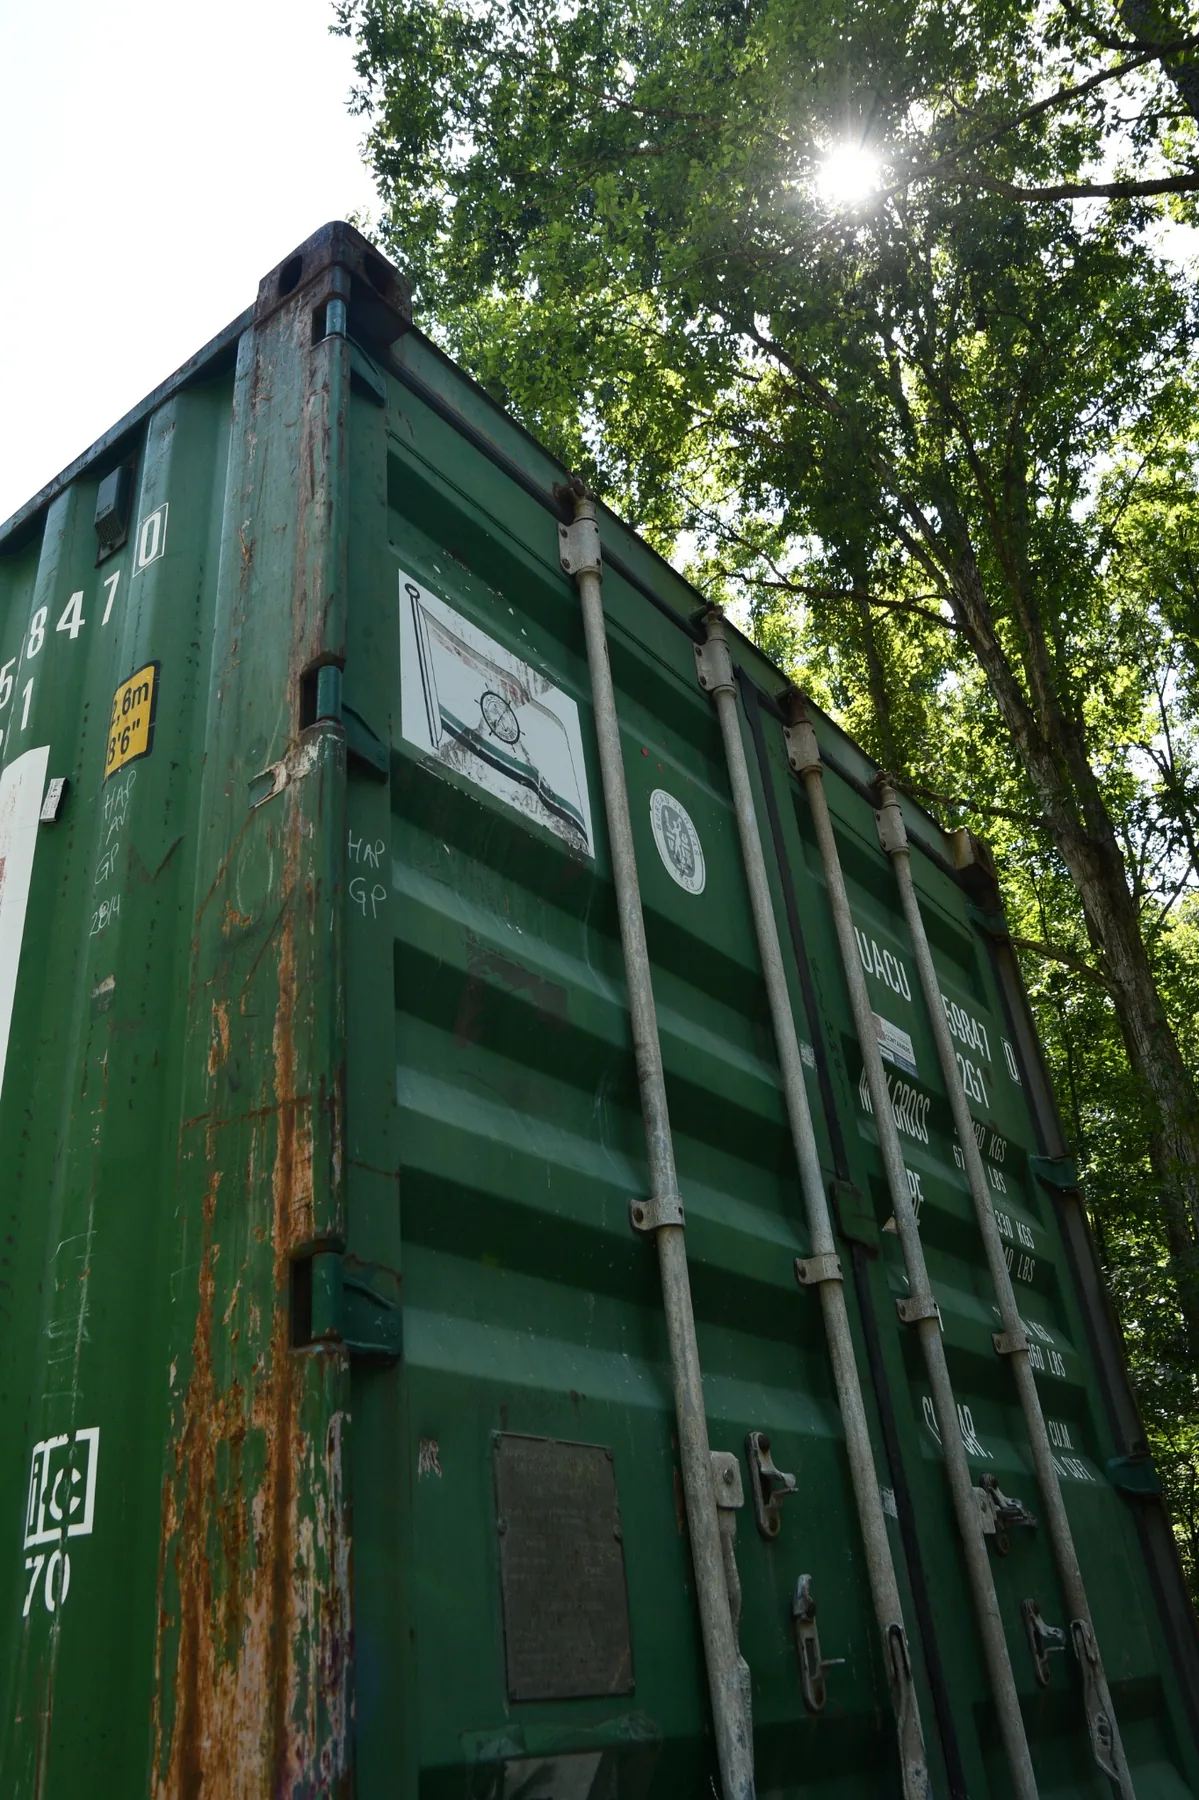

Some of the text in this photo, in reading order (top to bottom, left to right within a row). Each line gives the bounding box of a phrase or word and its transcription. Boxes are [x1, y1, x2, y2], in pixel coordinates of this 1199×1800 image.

[348, 877, 387, 919] GP
[854, 925, 911, 1002] UACU
[956, 1052, 990, 1109] 2G1
[891, 1080, 931, 1145] GROSS
[988, 1133, 1007, 1163] KGS
[987, 1164, 1007, 1194] LBS
[994, 1209, 1035, 1250] 330 KGS
[1017, 1253, 1036, 1283] LBS
[1047, 1348, 1066, 1378] LBS
[22, 1549, 71, 1617] 70
